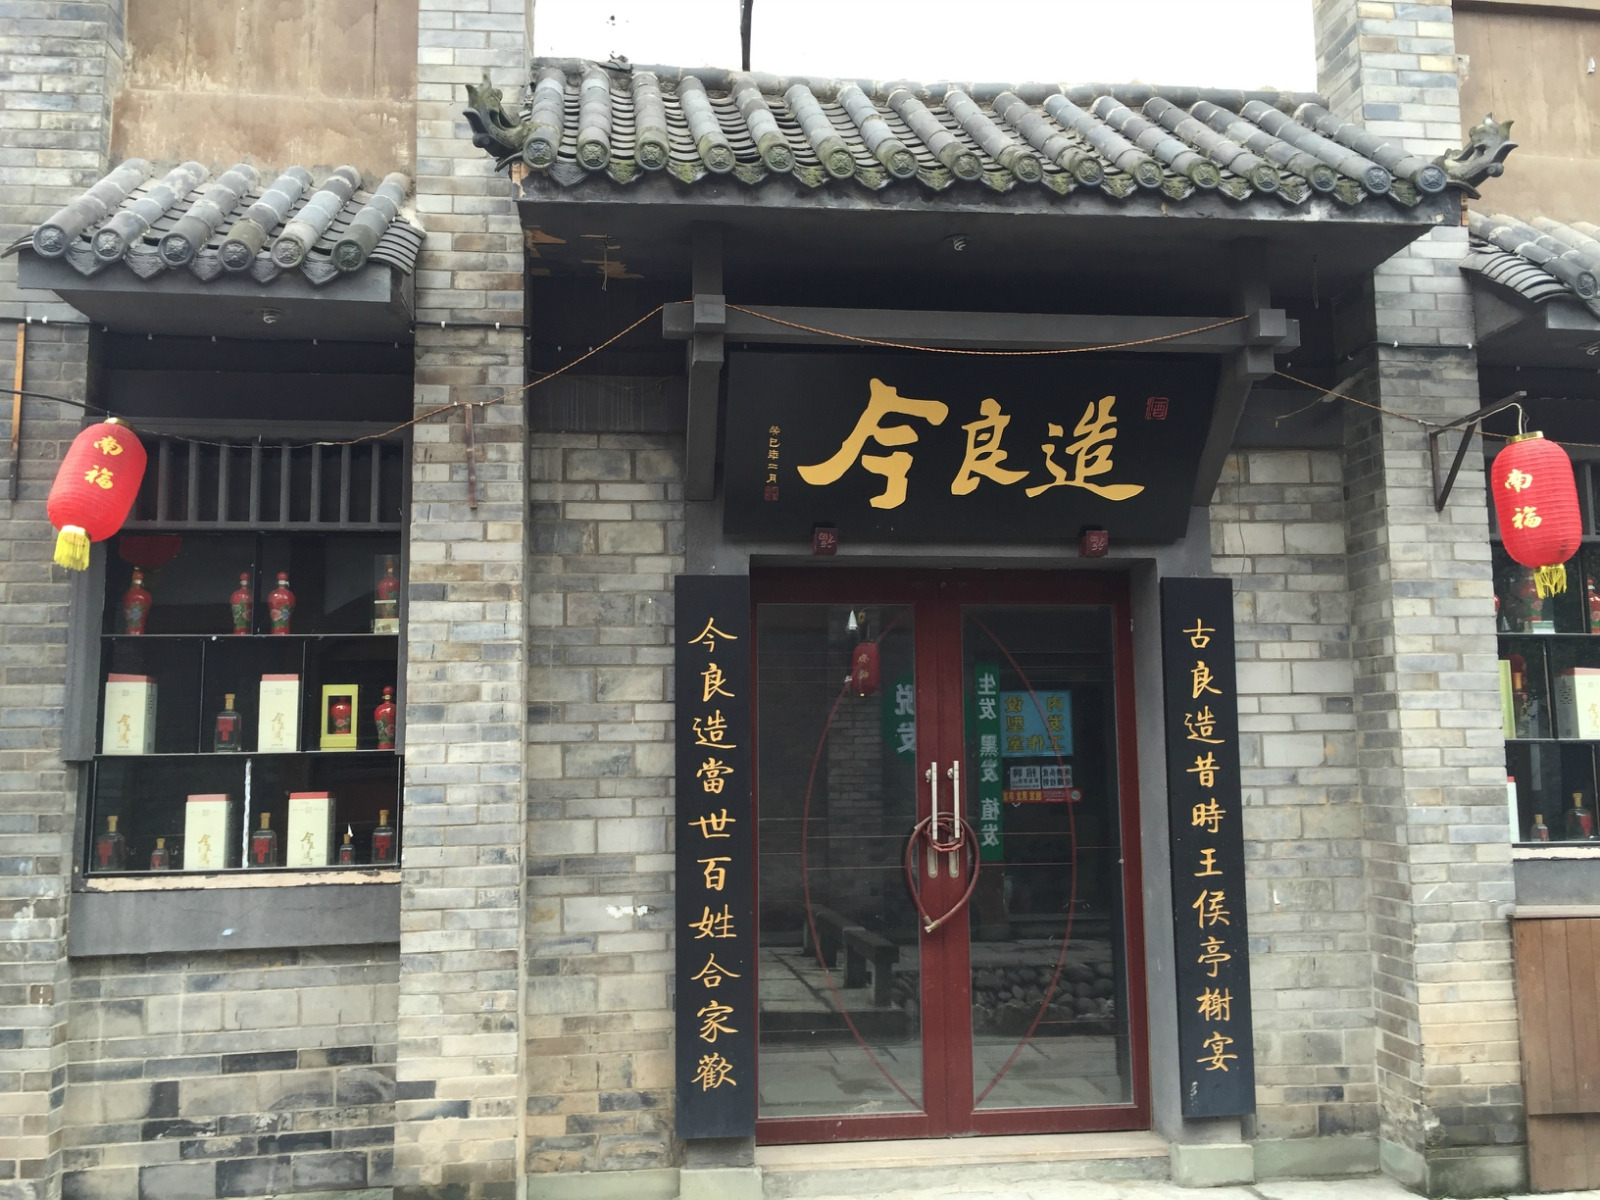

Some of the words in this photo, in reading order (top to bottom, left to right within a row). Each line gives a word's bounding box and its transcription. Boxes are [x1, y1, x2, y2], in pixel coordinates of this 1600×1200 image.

[797, 378, 1144, 509] 今良造
[1505, 469, 1542, 529] 南福
[688, 616, 740, 1091] 今良造當世百姓合家歡
[1183, 617, 1238, 1072] 古良造昔時王侯亭榭宴
